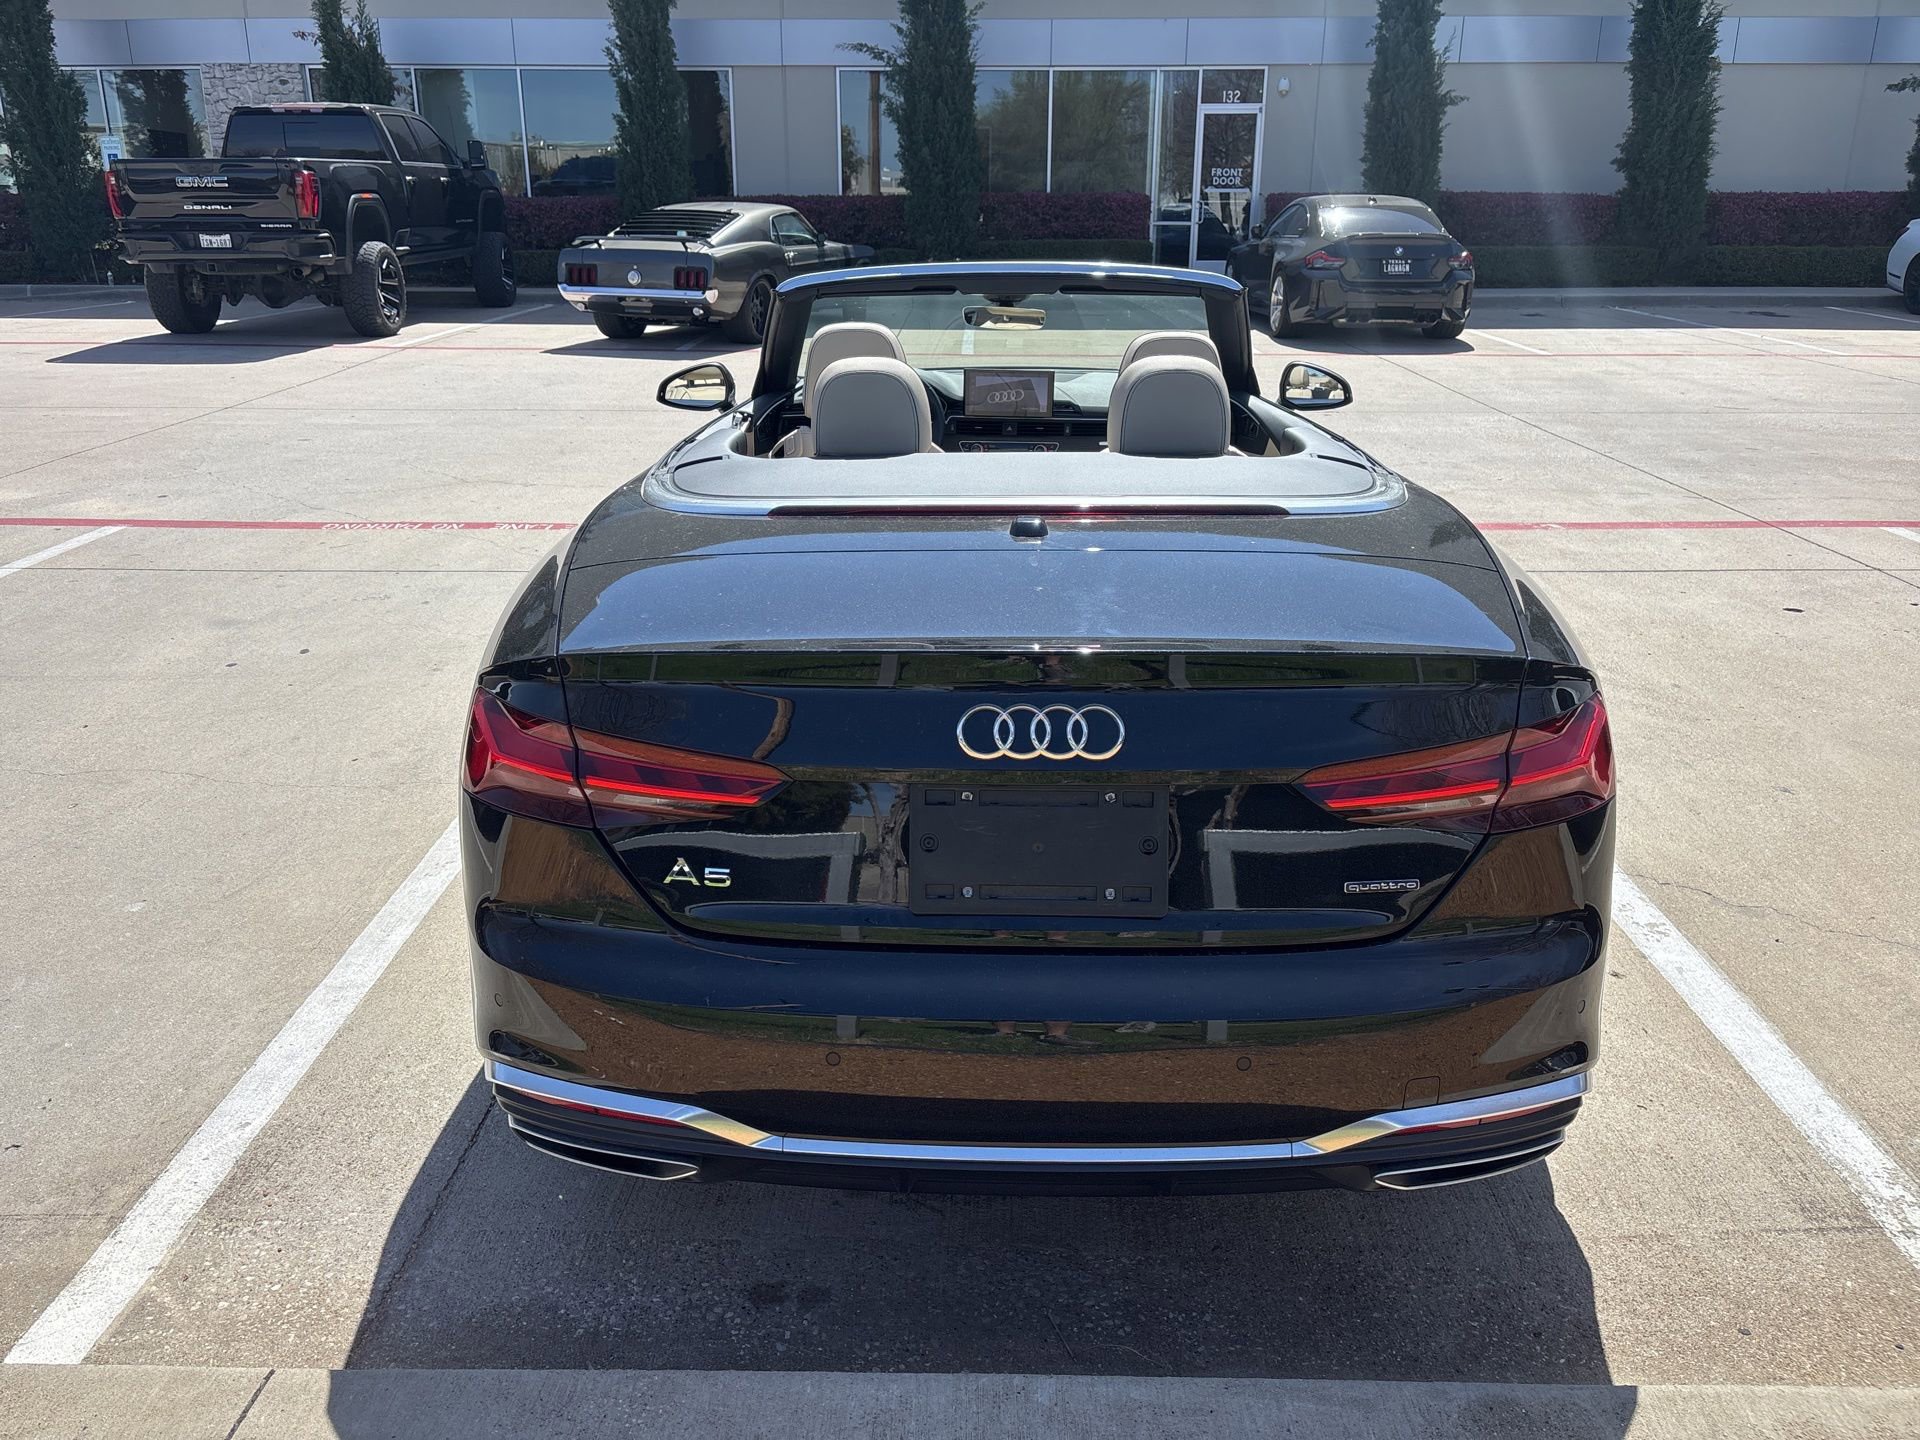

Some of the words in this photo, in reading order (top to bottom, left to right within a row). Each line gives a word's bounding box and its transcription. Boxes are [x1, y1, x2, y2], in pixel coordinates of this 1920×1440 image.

[1222, 90, 1241, 103] 132
[1211, 168, 1243, 177] FRONT
[175, 176, 229, 188] GMC
[1212, 177, 1242, 185] DOOR
[321, 522, 422, 530] PARKING
[431, 522, 465, 530] NO
[492, 522, 554, 530] LANE
[663, 857, 731, 887] A5
[1348, 882, 1417, 892] quattro
